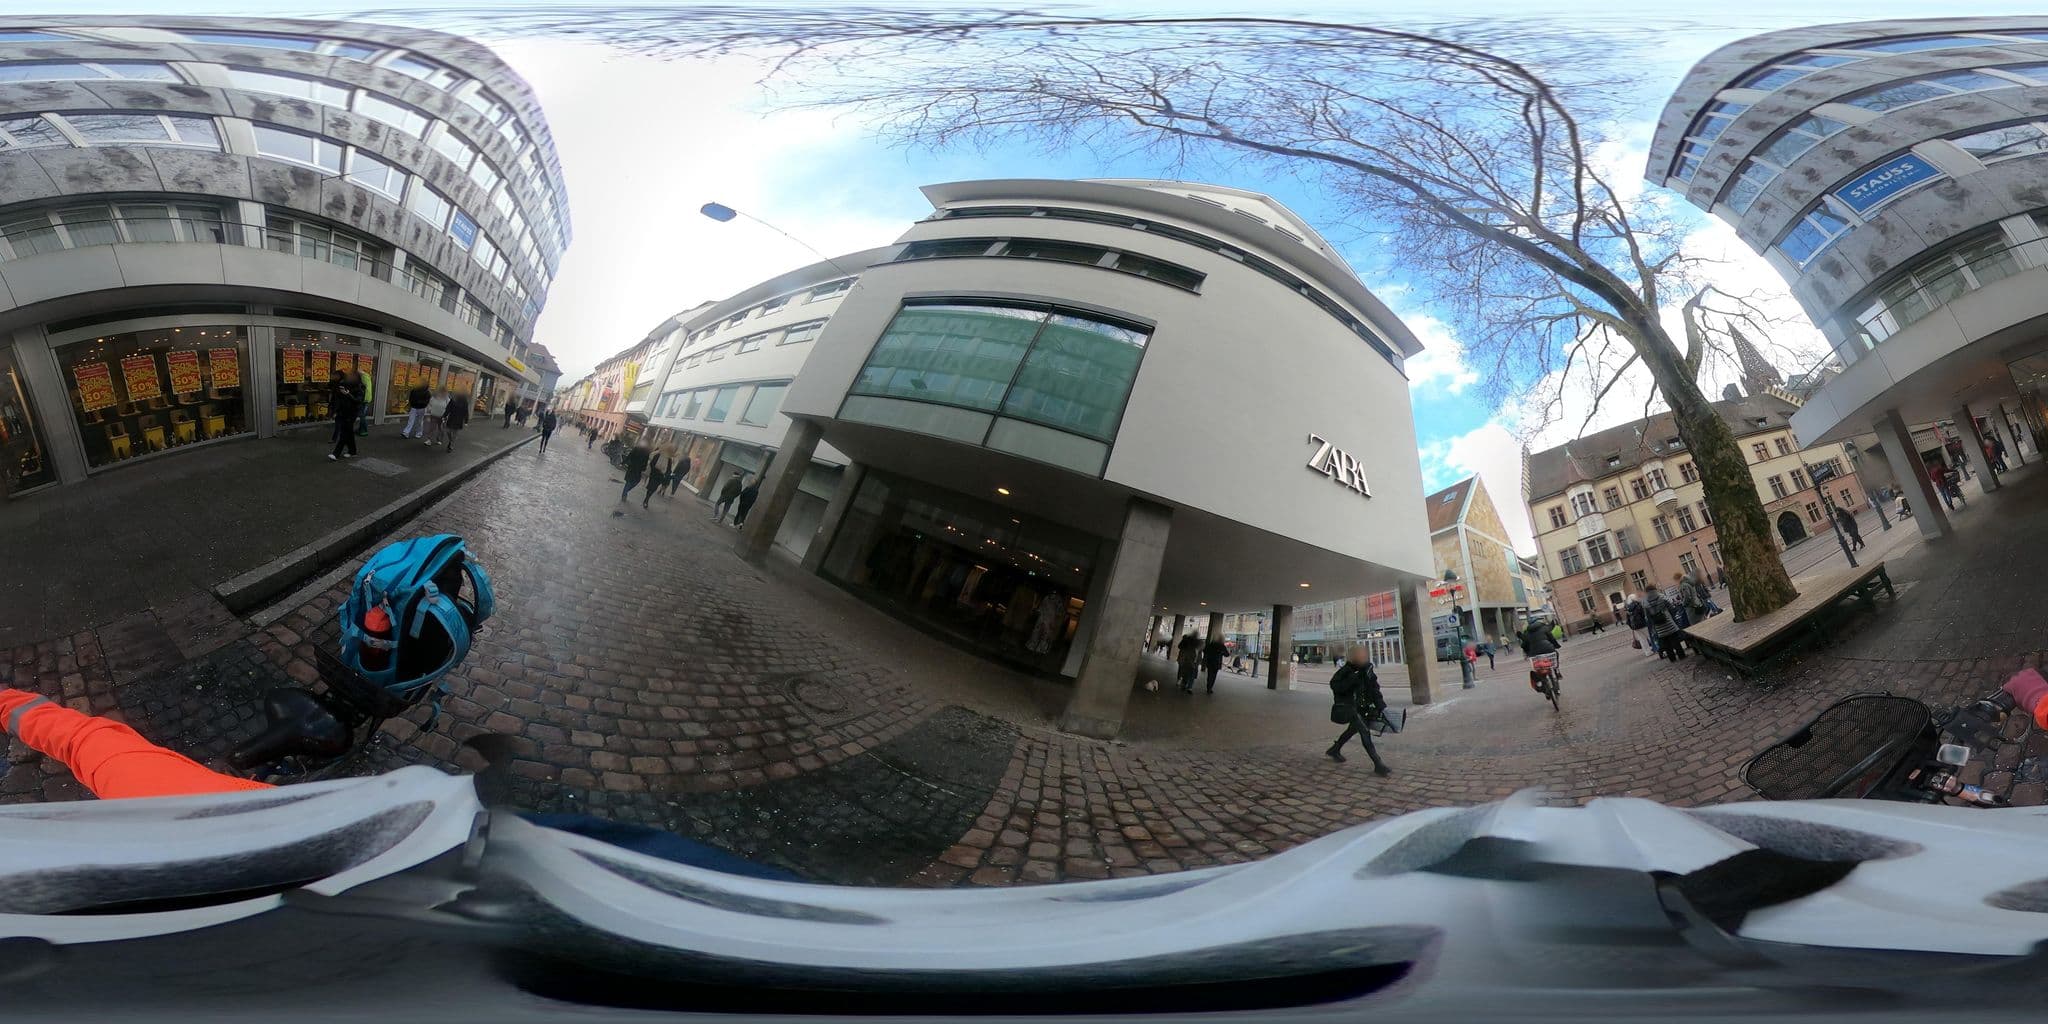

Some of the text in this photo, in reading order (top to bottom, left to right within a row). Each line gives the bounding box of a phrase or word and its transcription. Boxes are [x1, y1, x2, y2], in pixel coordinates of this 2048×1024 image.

[1850, 162, 1914, 198] STAUSS
[175, 375, 198, 386] 50%
[131, 381, 155, 393] 50%
[85, 390, 111, 402] 50%
[1308, 432, 1372, 498] ZARA
